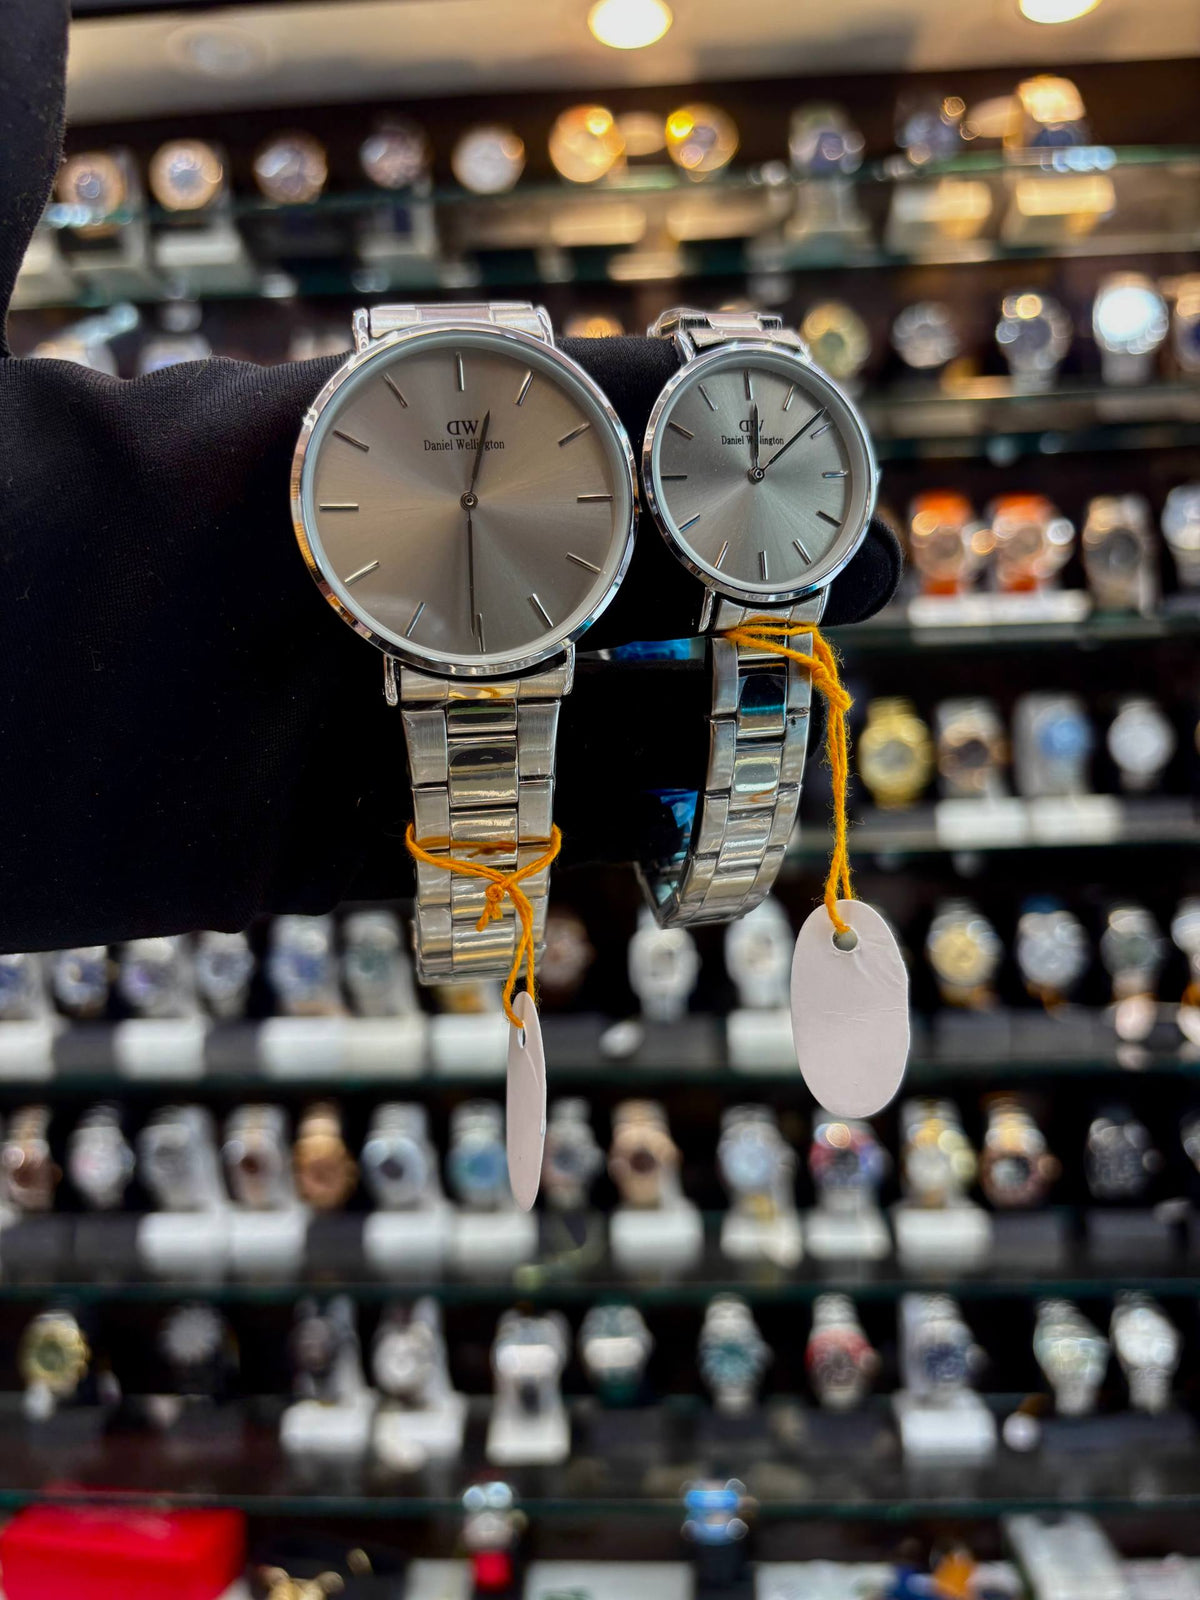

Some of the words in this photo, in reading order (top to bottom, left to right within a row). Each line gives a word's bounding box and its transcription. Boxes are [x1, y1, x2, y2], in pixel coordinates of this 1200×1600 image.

[424, 440, 453, 451] Daniel
[456, 439, 505, 451] Welligton
[721, 435, 744, 445] Daniel
[746, 436, 784, 446] Wlington
